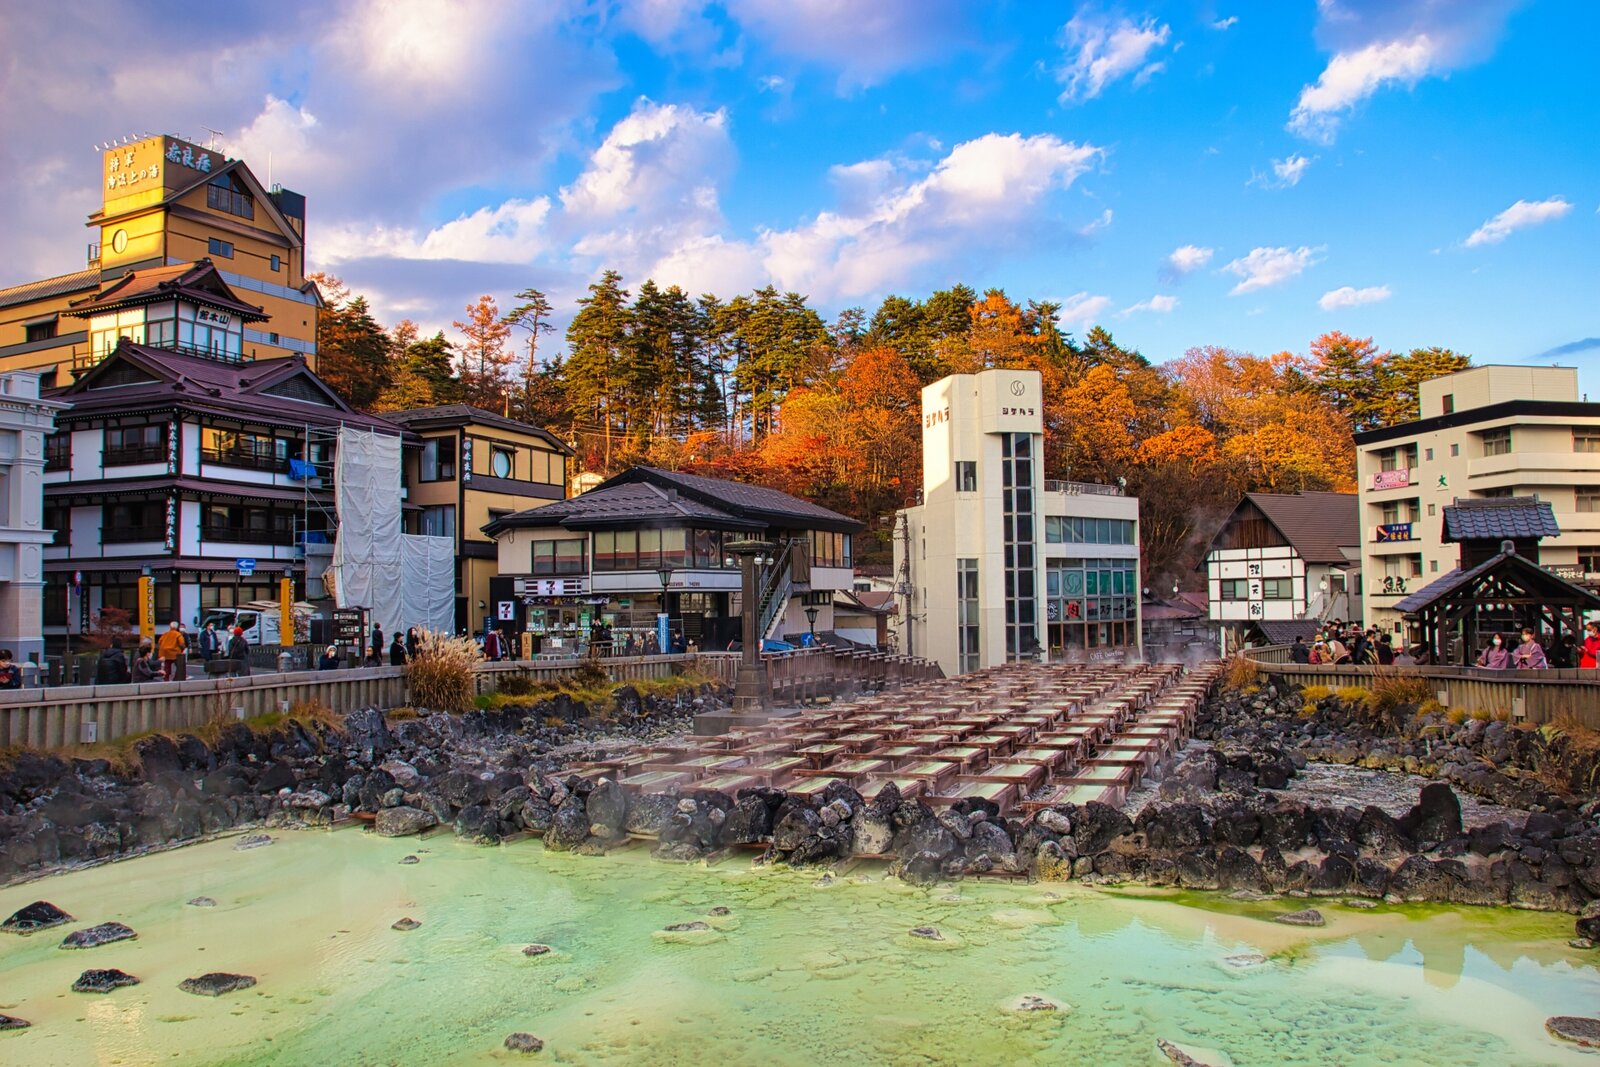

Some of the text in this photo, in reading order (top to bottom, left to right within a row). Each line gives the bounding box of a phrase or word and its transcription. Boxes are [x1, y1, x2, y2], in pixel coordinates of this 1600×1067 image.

[165, 142, 212, 173] 奈良屋
[1383, 576, 1407, 594] 魚民
[1100, 604, 1124, 615] ステーキ
